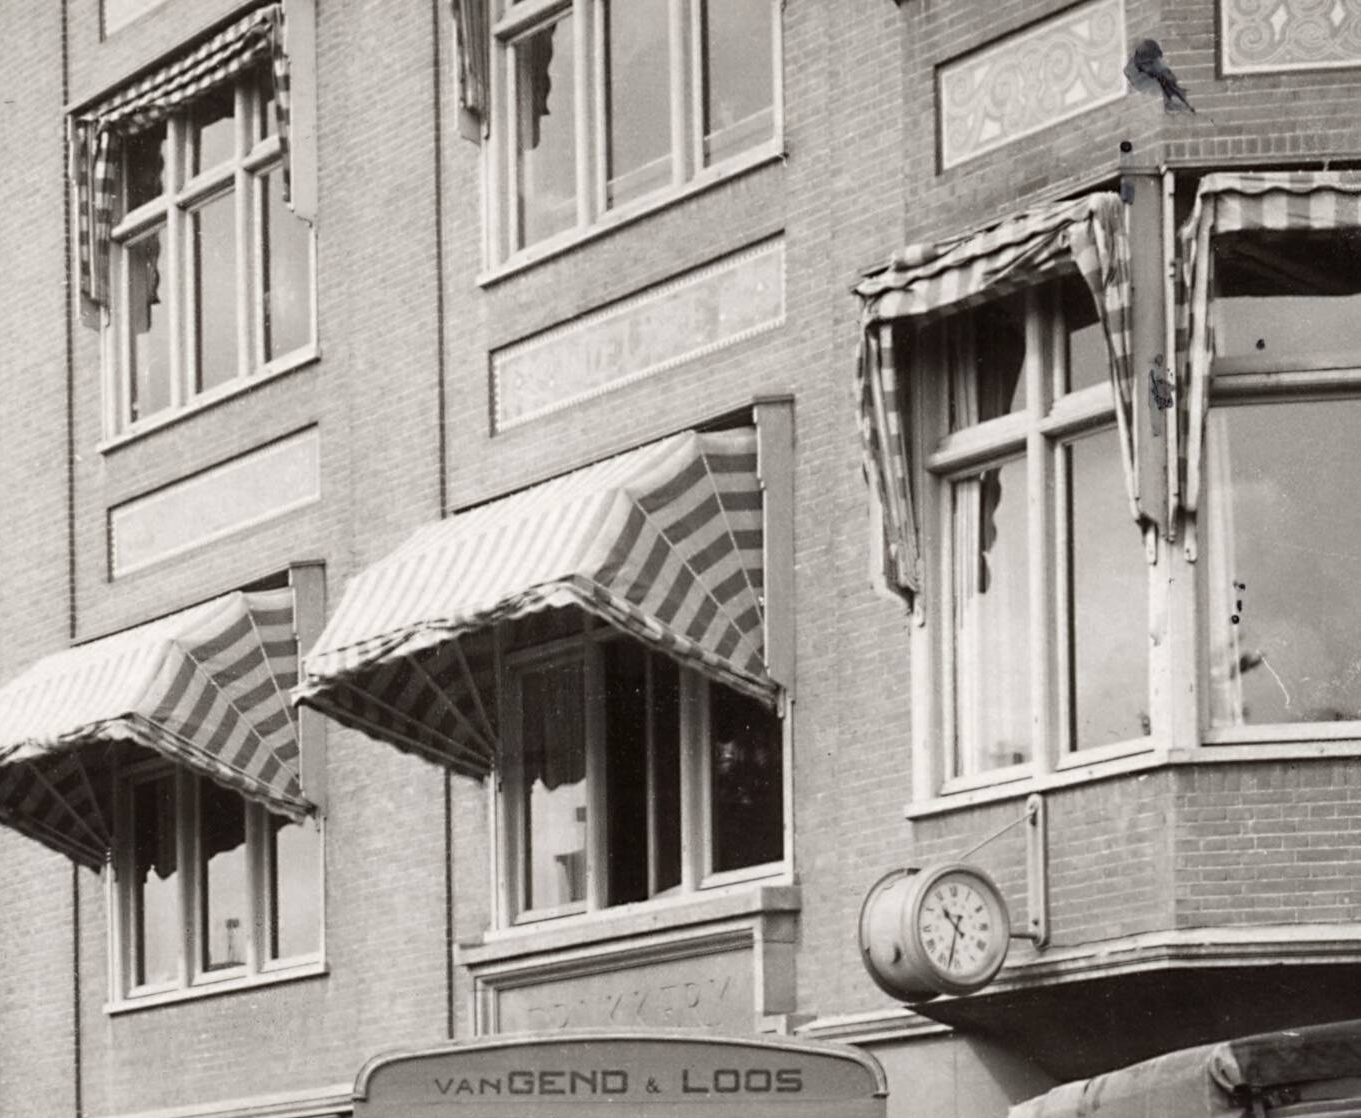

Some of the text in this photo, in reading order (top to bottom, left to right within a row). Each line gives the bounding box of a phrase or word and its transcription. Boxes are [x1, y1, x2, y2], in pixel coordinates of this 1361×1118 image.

[435, 1069, 803, 1095] VAN GEND & LOOS
